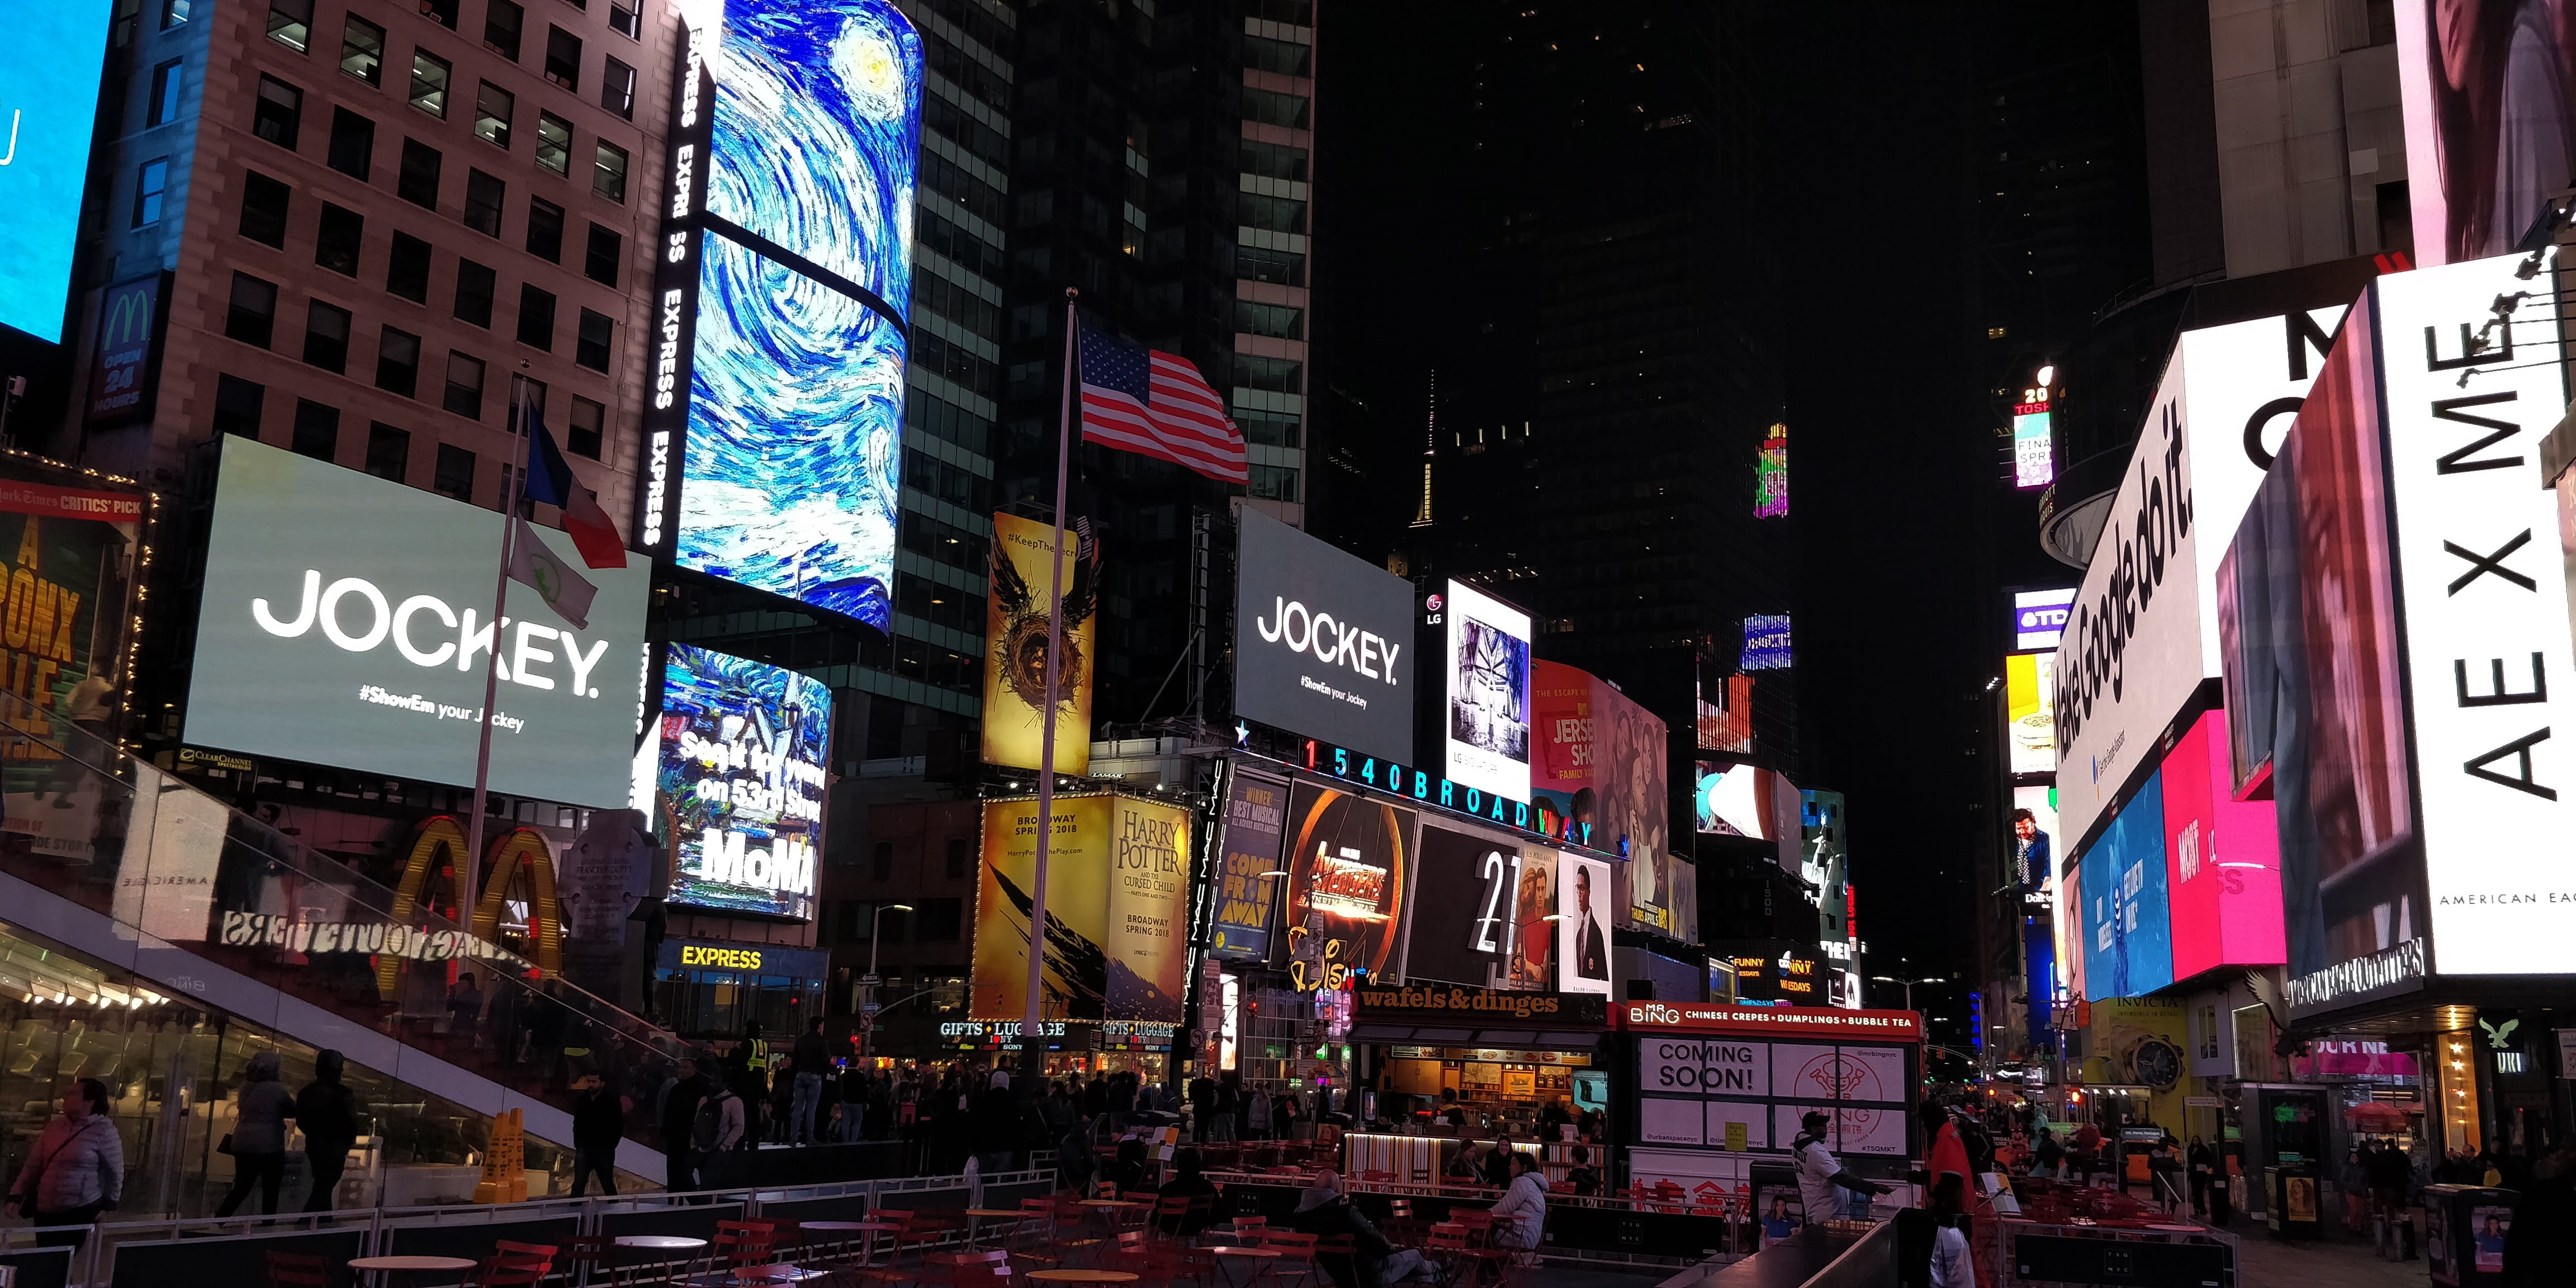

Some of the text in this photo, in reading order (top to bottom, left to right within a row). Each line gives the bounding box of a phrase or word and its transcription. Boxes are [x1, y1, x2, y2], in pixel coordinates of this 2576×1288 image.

[681, 26, 703, 128] EXPRESS
[105, 348, 142, 369] OPEN
[656, 288, 682, 410] EXPRESS
[105, 366, 134, 394] 24
[94, 391, 140, 413] HOURS
[2019, 439, 2051, 451] FINA
[644, 430, 670, 547] EXPRESS
[60, 495, 111, 513] CRITICS'
[113, 501, 142, 514] PICK
[17, 514, 39, 570] A
[2080, 519, 2135, 721] Google
[2136, 456, 2165, 613] do
[1427, 614, 1442, 625] LG
[1300, 675, 1367, 711] #ShowEm your Jockey
[1554, 688, 1579, 697] ESCAPE
[359, 684, 525, 734] #ShowEm your Jckey
[1554, 718, 1596, 744] JERSE
[1453, 752, 1462, 764] LG
[1571, 744, 1596, 766] SHO
[1559, 768, 1584, 780] FAMILY
[697, 779, 728, 802] on
[1246, 787, 1273, 807] WINNER!
[1018, 815, 1076, 825] BROWAY
[1233, 799, 1280, 826] BEST MUSICAL
[1016, 825, 1077, 835] SPRIG 2018
[1123, 810, 1181, 850] HARRY
[701, 827, 813, 896] MoMA
[1007, 848, 1082, 858] HarryPothePlay.com
[1117, 838, 1183, 876] POTTER
[1227, 851, 1275, 881] COME
[1124, 875, 1176, 893] CURSED CHILD
[1470, 849, 1522, 956] 21
[2440, 893, 2536, 905] AMERICAN
[1128, 914, 1169, 927] BROADWAY
[1219, 899, 1269, 927] AWAY
[1631, 907, 1645, 922] THURS
[1126, 925, 1169, 937] SPRING 2018
[681, 945, 761, 969] EXPRESS
[1734, 958, 1764, 967] FUNNY
[1646, 1003, 1665, 1012] MR
[2117, 997, 2179, 1007] INVICTA
[1630, 1007, 1679, 1024] BING
[1685, 1010, 1912, 1027] CHINESE CREPES DUMPLINGS BUBBLE TEA
[940, 1022, 1065, 1036] GIFTS LUGAGE
[1103, 1022, 1174, 1038] GIFTS LUGGAGE
[1659, 1044, 1754, 1063] COMING
[1659, 1065, 1754, 1090] SOON!
[1647, 1134, 1698, 1143] @urbanspacenyc
